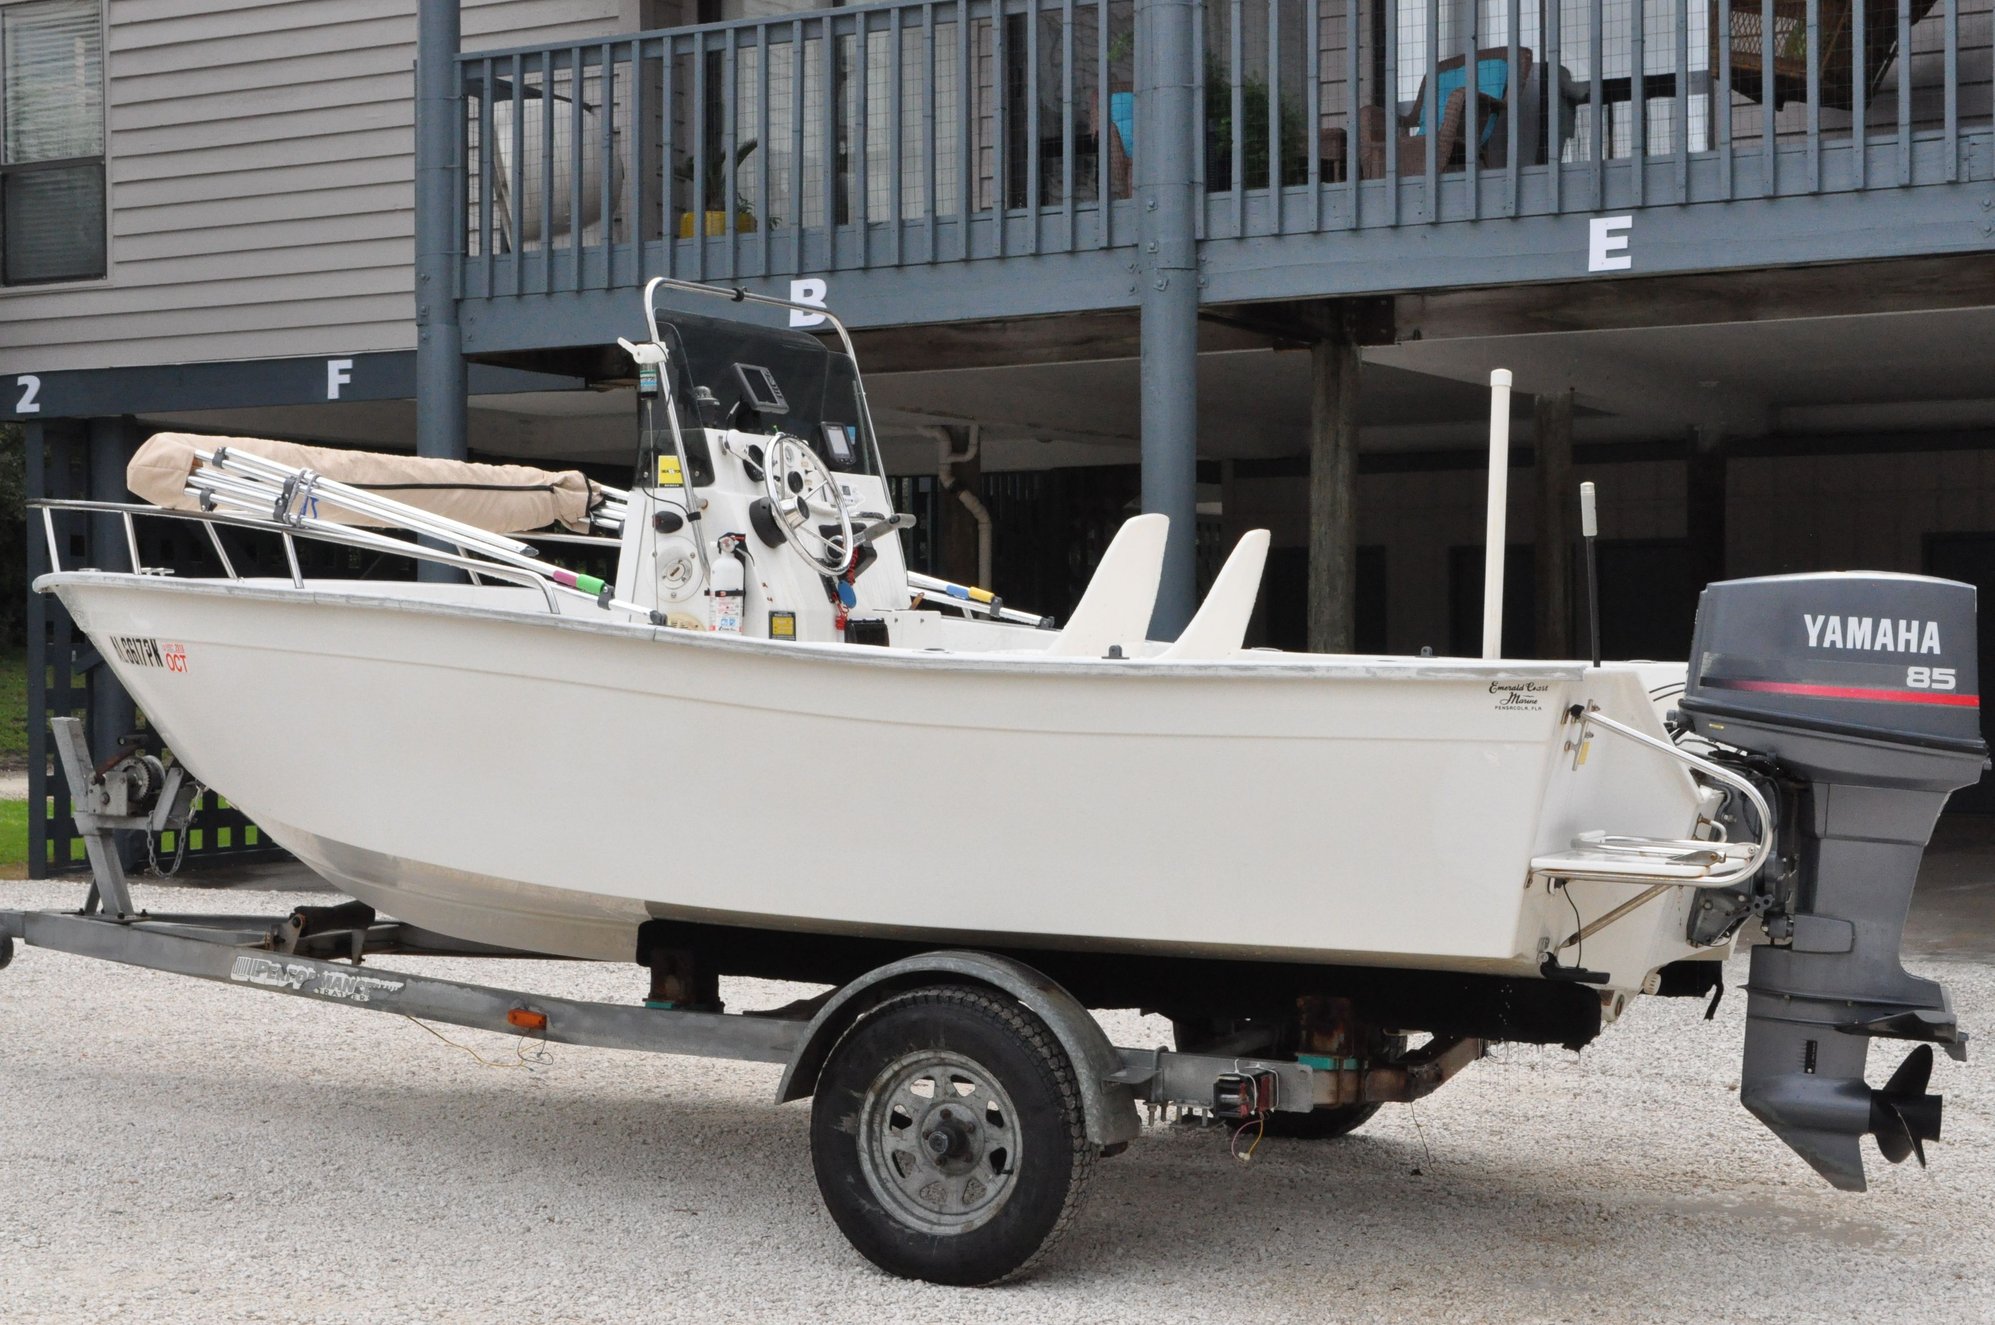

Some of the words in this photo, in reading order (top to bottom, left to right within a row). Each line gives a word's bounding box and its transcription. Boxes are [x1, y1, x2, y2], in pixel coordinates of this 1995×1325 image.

[1588, 215, 1633, 272] E
[789, 278, 827, 327] B
[16, 375, 41, 414] 2
[327, 359, 353, 400] F
[1803, 614, 1941, 655] YAMAHA
[166, 653, 188, 673] OCT
[1906, 666, 1956, 690] 85
[1489, 680, 1524, 694] Emerald
[1526, 682, 1549, 692] Coast
[1499, 692, 1538, 705] Marine
